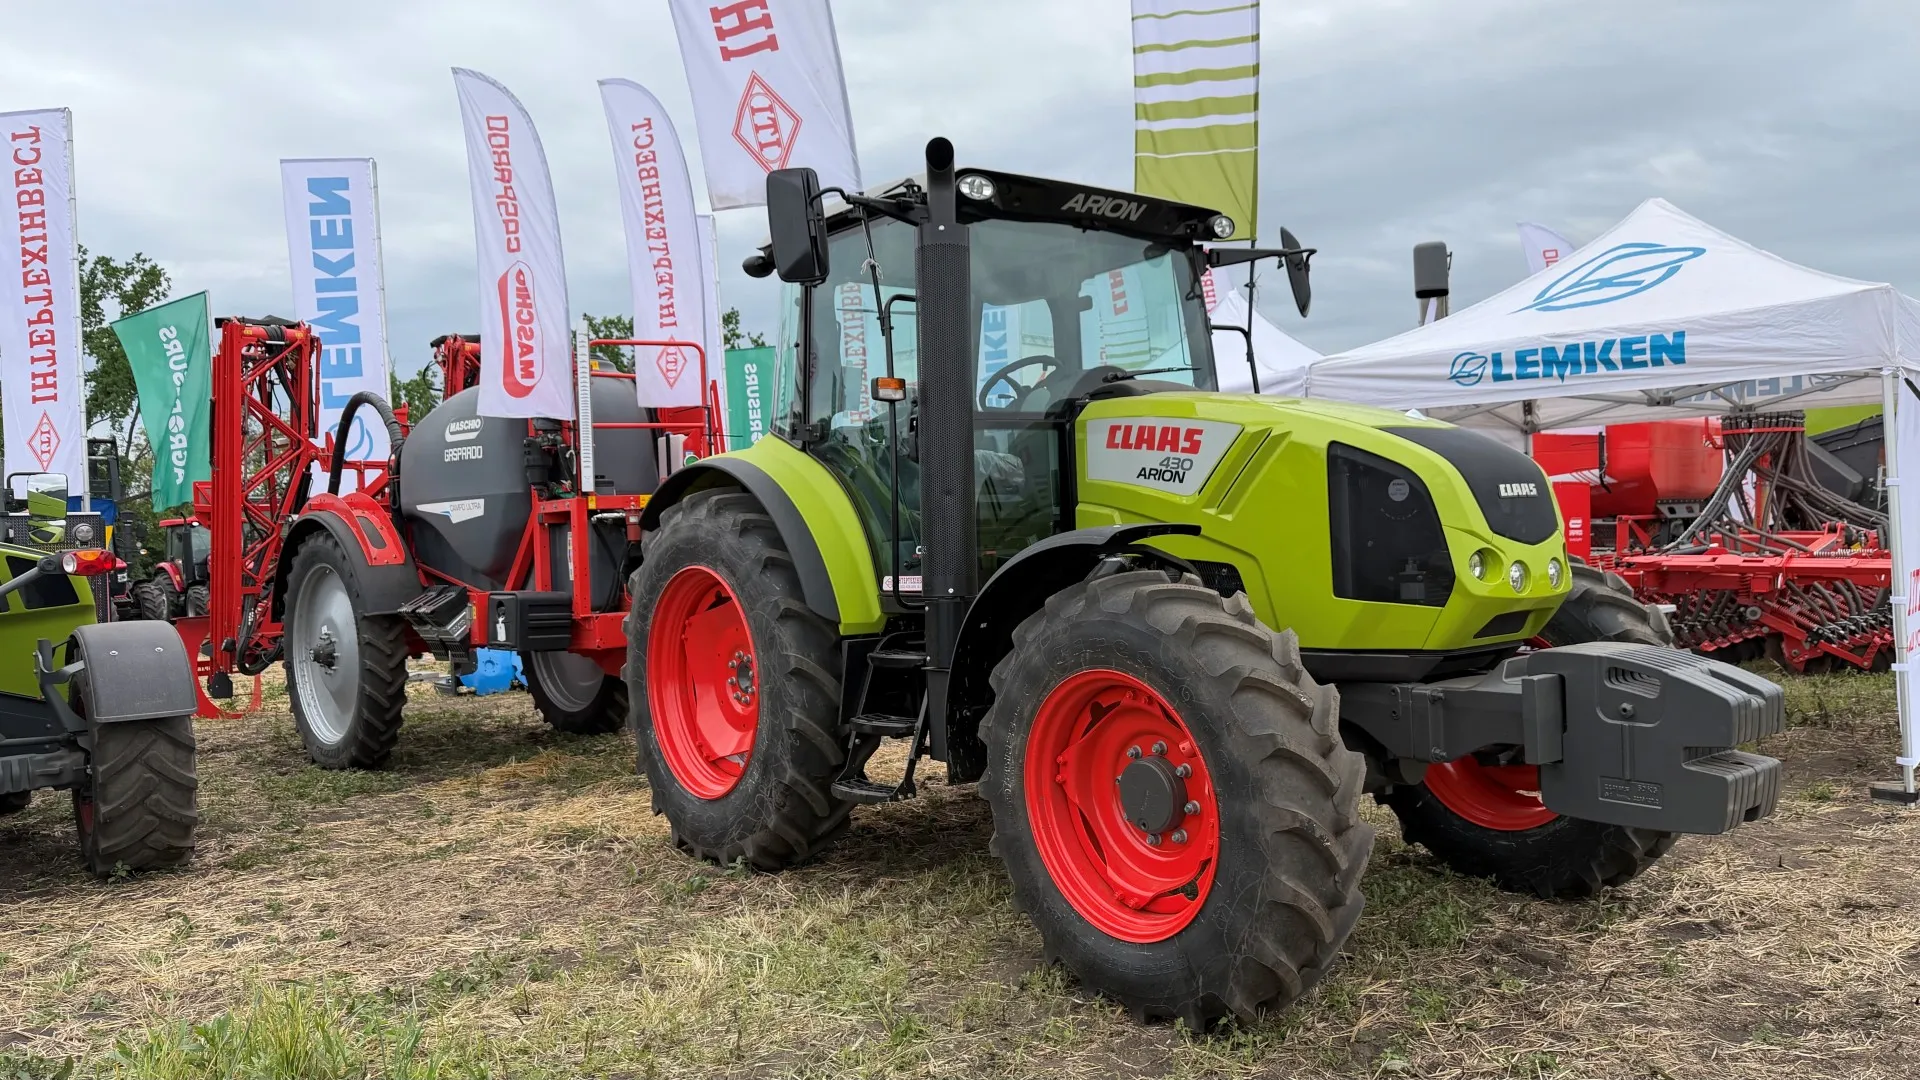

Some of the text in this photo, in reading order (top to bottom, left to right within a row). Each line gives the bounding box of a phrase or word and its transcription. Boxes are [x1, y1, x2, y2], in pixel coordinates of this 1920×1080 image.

[1061, 193, 1147, 222] ARION
[1491, 330, 1686, 384] LEMKEN
[450, 419, 481, 432] MASCHIO
[1105, 424, 1204, 455] CLAAS
[444, 445, 483, 462] GASPARDO
[1158, 456, 1194, 472] 430
[1136, 467, 1186, 484] ARION
[1498, 482, 1539, 498] CLAAS
[449, 502, 481, 512] CAMPO ULTRA
